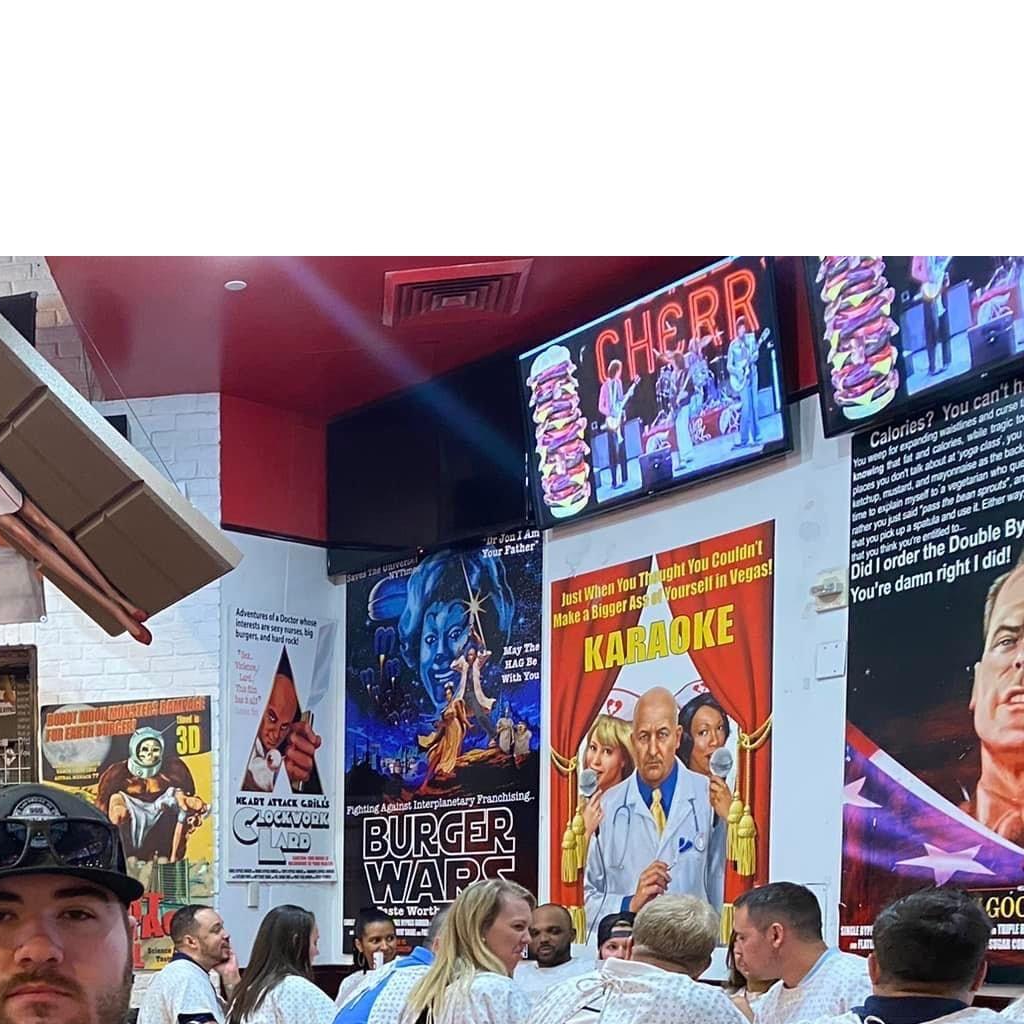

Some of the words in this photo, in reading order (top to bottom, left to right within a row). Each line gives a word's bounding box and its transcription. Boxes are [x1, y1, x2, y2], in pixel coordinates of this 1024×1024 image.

[870, 411, 934, 448] Calories?
[942, 401, 969, 421] You
[973, 383, 1009, 410] can't
[853, 464, 884, 481] knowing
[886, 457, 901, 470] that
[903, 453, 913, 462] fat
[915, 448, 930, 459] and
[967, 427, 987, 441] while
[991, 418, 1013, 434] tragic
[854, 457, 866, 468] You
[888, 444, 898, 455] for
[899, 431, 938, 451] expanding
[978, 408, 994, 423] and
[996, 402, 1018, 417] curse
[852, 481, 875, 496] places
[876, 477, 889, 489] you
[891, 467, 909, 482] don't
[910, 465, 923, 476] talk
[925, 456, 947, 472] about
[948, 451, 956, 463] at
[1007, 431, 1022, 445] you
[882, 481, 914, 498] mustard,
[915, 477, 930, 488] and
[931, 461, 977, 482] mayonnaise
[978, 456, 988, 467] as
[990, 451, 1002, 463] the
[852, 510, 867, 521] time
[868, 507, 876, 517] to
[877, 499, 903, 514] explain
[904, 490, 929, 504] myself
[930, 487, 938, 497] to
[948, 471, 988, 491] vegetarian
[990, 465, 1007, 477] who
[851, 523, 873, 535] rather
[874, 518, 887, 528] you
[888, 513, 901, 526] just
[902, 508, 918, 520] said
[942, 497, 954, 508] the
[956, 490, 976, 503] bean
[851, 538, 865, 549] that
[866, 535, 879, 547] you
[880, 529, 895, 543] pick
[896, 526, 905, 536] up
[913, 515, 941, 530] spatula
[941, 510, 956, 523] and
[957, 506, 972, 517] use
[982, 495, 1006, 510] Either
[482, 548, 503, 558] Your
[504, 541, 539, 556] Father"
[499, 533, 516, 544] Jon
[517, 532, 523, 541] I
[523, 530, 540, 539] Am
[851, 552, 865, 562] that
[866, 548, 879, 560] you
[880, 541, 898, 554] think
[899, 536, 921, 551] you're
[922, 526, 950, 542] entitled
[851, 558, 872, 580] Did
[876, 558, 880, 573] I
[883, 548, 920, 571] order
[922, 541, 946, 561] the
[949, 524, 1001, 554] Double
[553, 610, 581, 629] Make
[583, 609, 590, 621] a
[591, 600, 627, 620] Bigger
[629, 593, 646, 610] Ass
[665, 577, 713, 602] Yourself
[715, 574, 727, 590] in
[730, 558, 774, 585] Vegas!
[561, 590, 583, 608] Just
[585, 582, 615, 601] When
[616, 578, 636, 591] You
[638, 561, 686, 587] Thought
[688, 556, 709, 574] You
[711, 542, 764, 568] Couldn't
[850, 581, 891, 604] You're
[895, 571, 933, 592] damn
[937, 557, 970, 583] right
[974, 554, 978, 572] I
[982, 545, 1012, 569] did!
[236, 608, 268, 620] Adventures
[269, 612, 276, 621] of
[280, 614, 299, 625] Doctor
[299, 618, 317, 627] whose
[236, 618, 260, 630] interests
[270, 625, 283, 635] sexy
[304, 628, 314, 639] big
[260, 633, 271, 642] and
[272, 634, 285, 643] hard
[503, 647, 522, 657] May
[523, 643, 540, 653] The
[584, 604, 736, 673] KARAOKE
[501, 672, 522, 684] With
[523, 672, 539, 681] You
[505, 659, 525, 669] HAG
[527, 658, 537, 667] Be
[108, 701, 160, 721] MONSTERS
[46, 726, 64, 743] FOR
[65, 723, 95, 740] EARTH
[176, 725, 201, 756] 3D
[236, 796, 264, 806] HEART
[267, 798, 298, 807] ATTACK
[346, 803, 379, 815] Fighting
[381, 801, 412, 814] Against
[413, 796, 475, 811] Interplanetary
[233, 806, 330, 845] CLOCKWORK
[363, 806, 516, 860] BURGER
[258, 828, 311, 865] LARD
